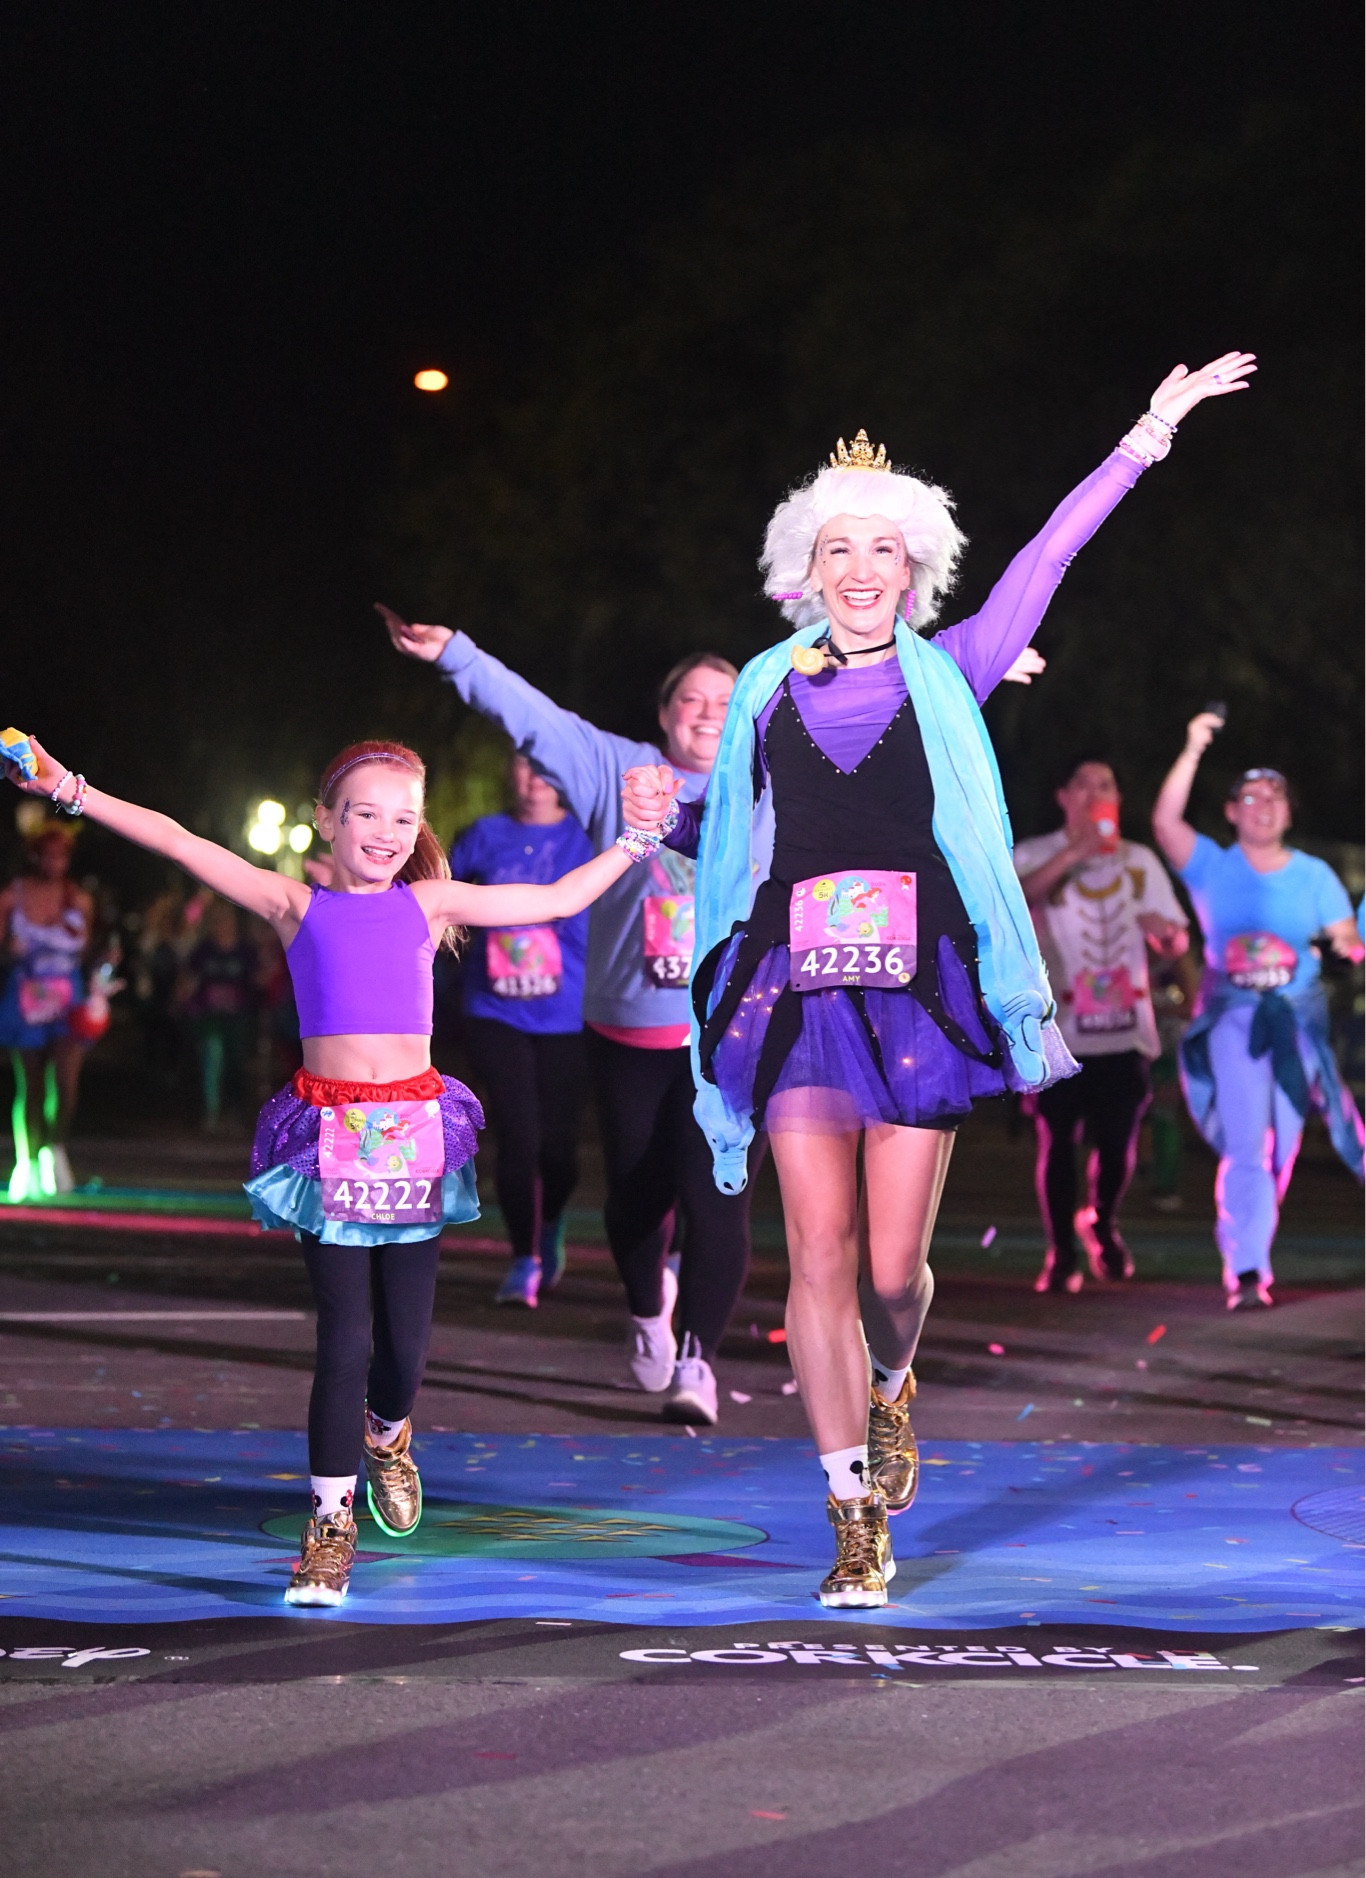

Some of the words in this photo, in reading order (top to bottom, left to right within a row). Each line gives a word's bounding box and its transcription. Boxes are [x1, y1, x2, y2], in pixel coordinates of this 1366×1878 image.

[794, 900, 804, 932] 42236
[800, 946, 904, 977] 42236
[323, 1128, 335, 1158] 42222
[333, 1179, 432, 1210] 42222
[371, 1213, 396, 1221] CHLOE
[619, 1648, 1260, 1671] CORKCICLE.
[733, 1642, 1027, 1653] PRESENTED
[1053, 1646, 1114, 1654] BY
